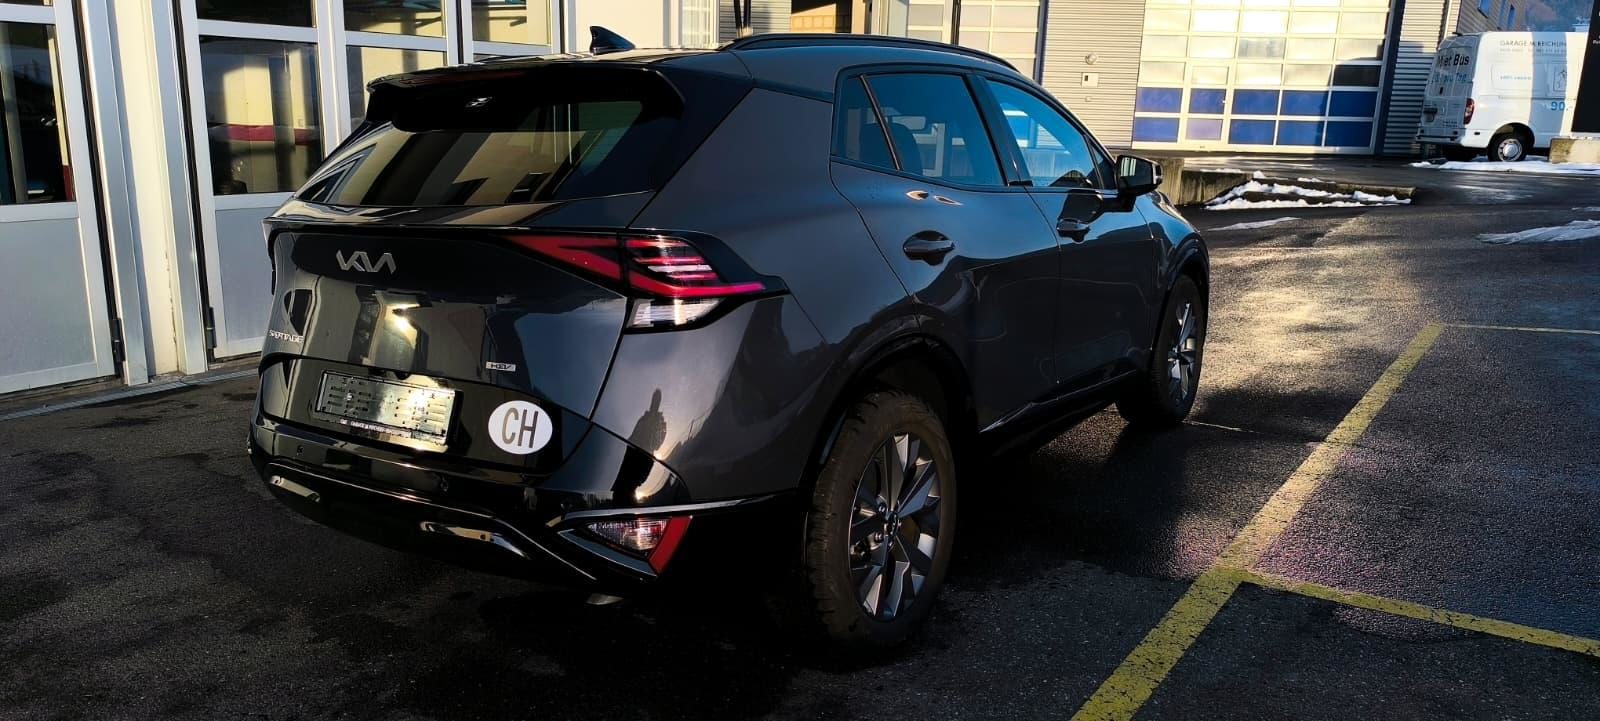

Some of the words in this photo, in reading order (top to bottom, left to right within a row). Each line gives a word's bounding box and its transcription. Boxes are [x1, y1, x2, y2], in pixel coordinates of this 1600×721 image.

[1453, 53, 1470, 66] Bus
[336, 250, 397, 275] KIA
[502, 407, 539, 449] CH
